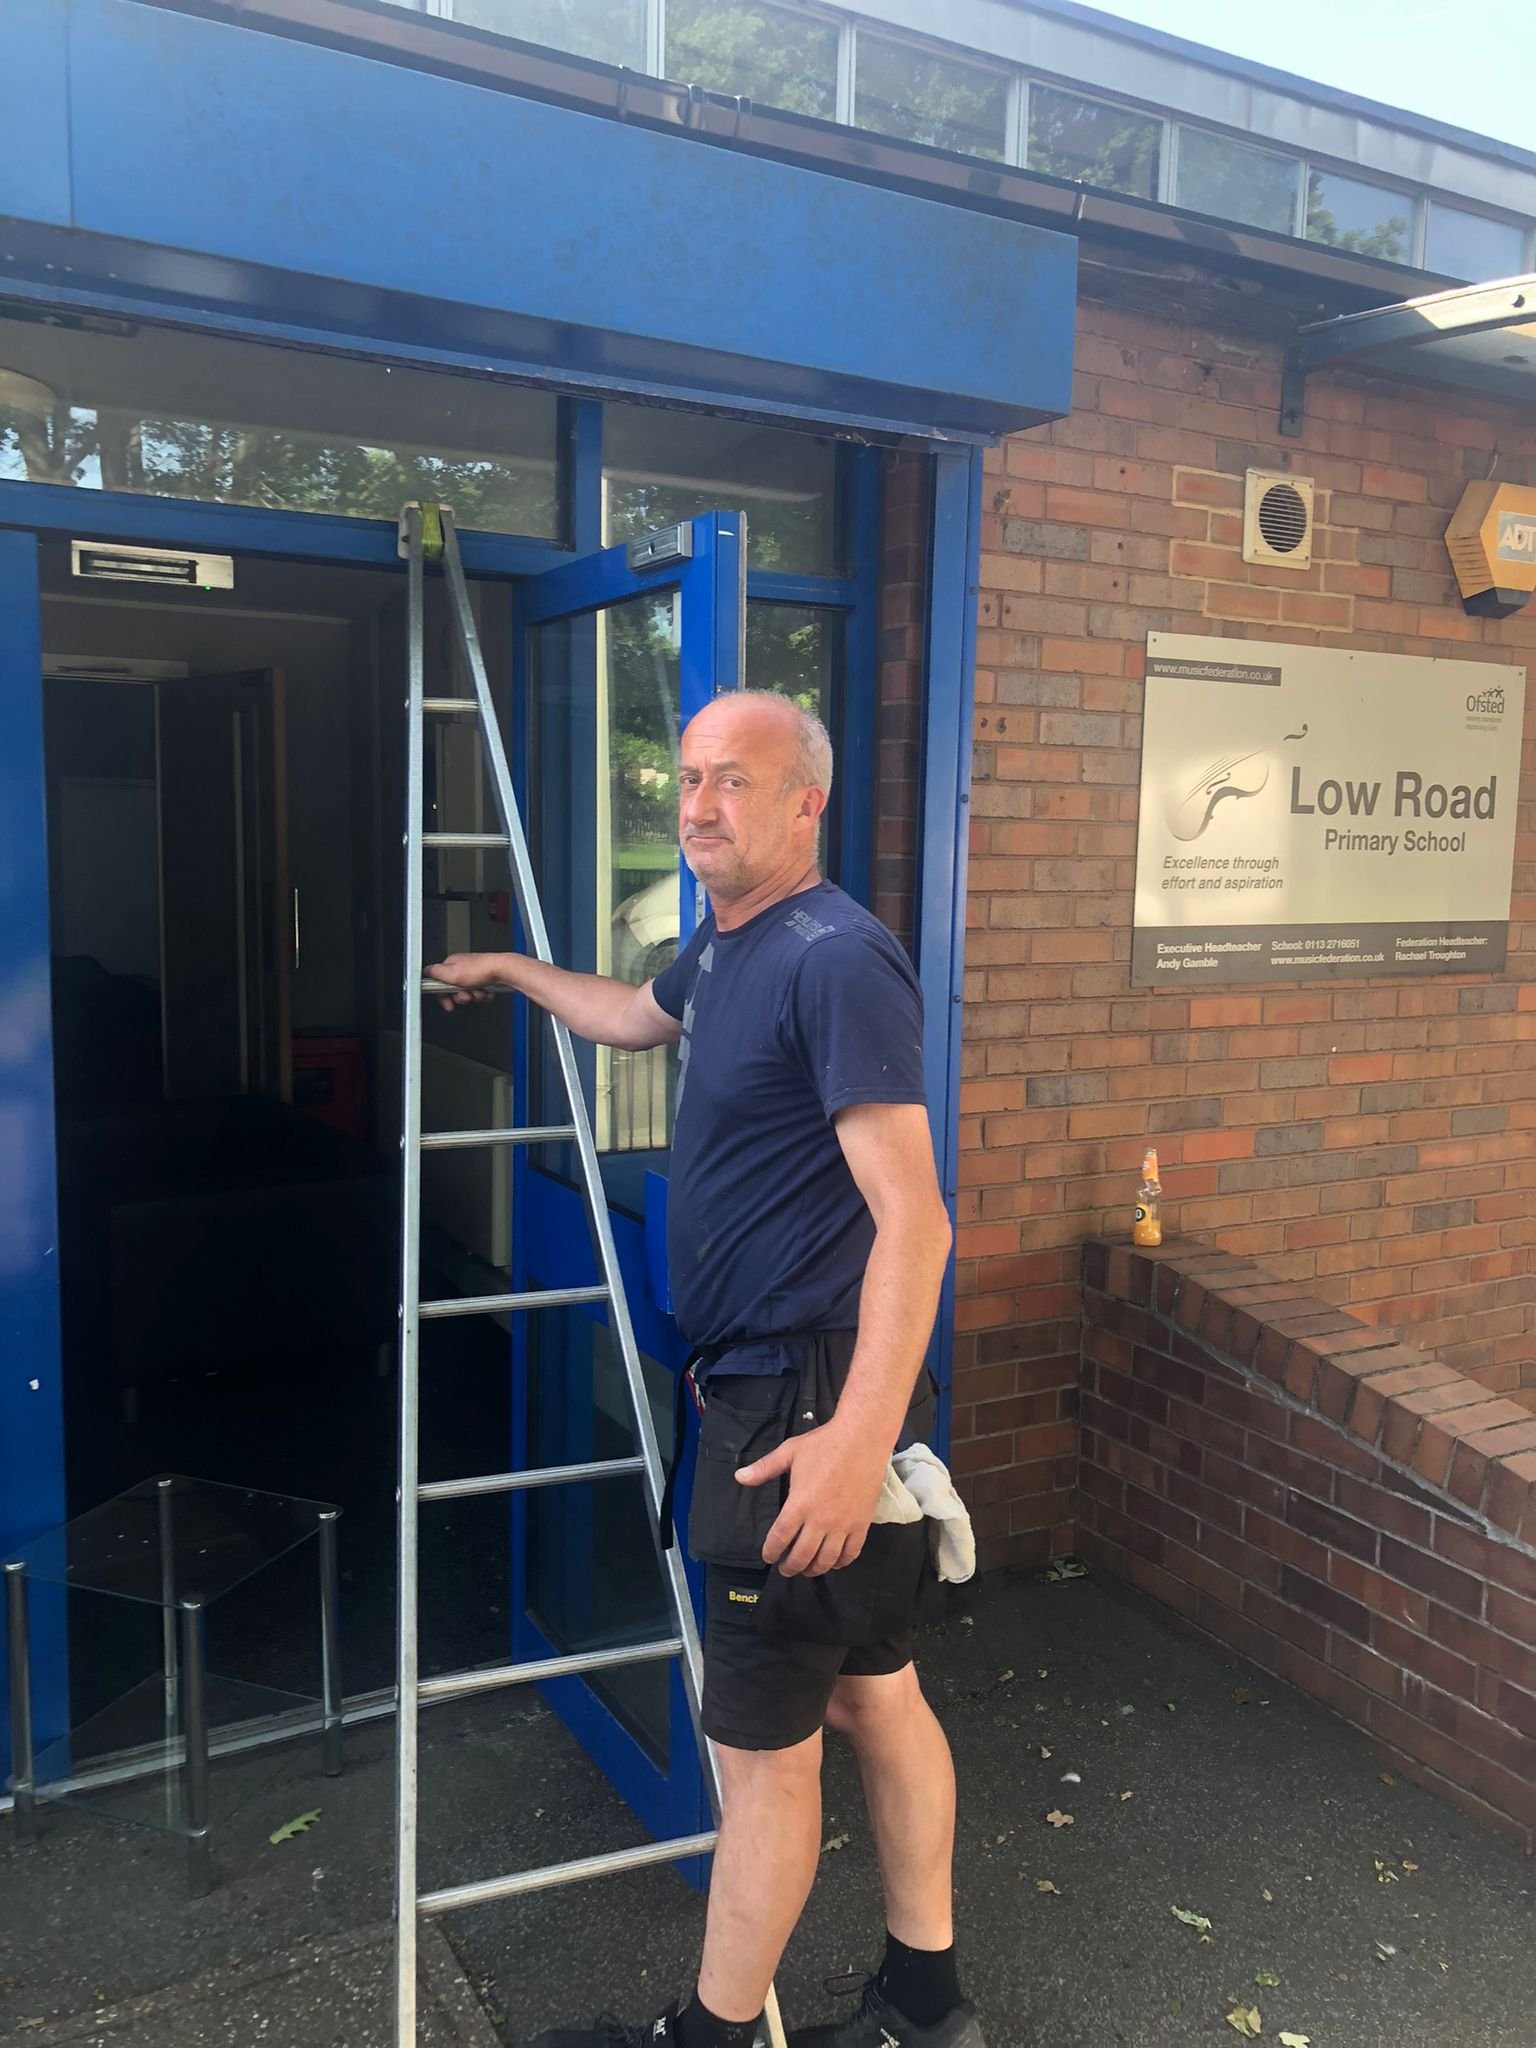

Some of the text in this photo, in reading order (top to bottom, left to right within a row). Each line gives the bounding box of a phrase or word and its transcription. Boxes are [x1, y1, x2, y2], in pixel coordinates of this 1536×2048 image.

[1499, 523, 1536, 553] ADT
[1153, 663, 1273, 681] www.musicfederation.co.uk
[1466, 694, 1505, 714] Ofsted
[1290, 766, 1497, 820] Low Road
[1324, 828, 1466, 856] Primary School
[1163, 855, 1280, 872] Excellence through
[1161, 876, 1284, 892] effort and aspiration
[1157, 941, 1262, 954] Executive Headteacher
[1395, 937, 1438, 947] Federation
[1156, 957, 1219, 970] Andy Gamble
[1270, 952, 1385, 965] www.musicfederation.co.uk
